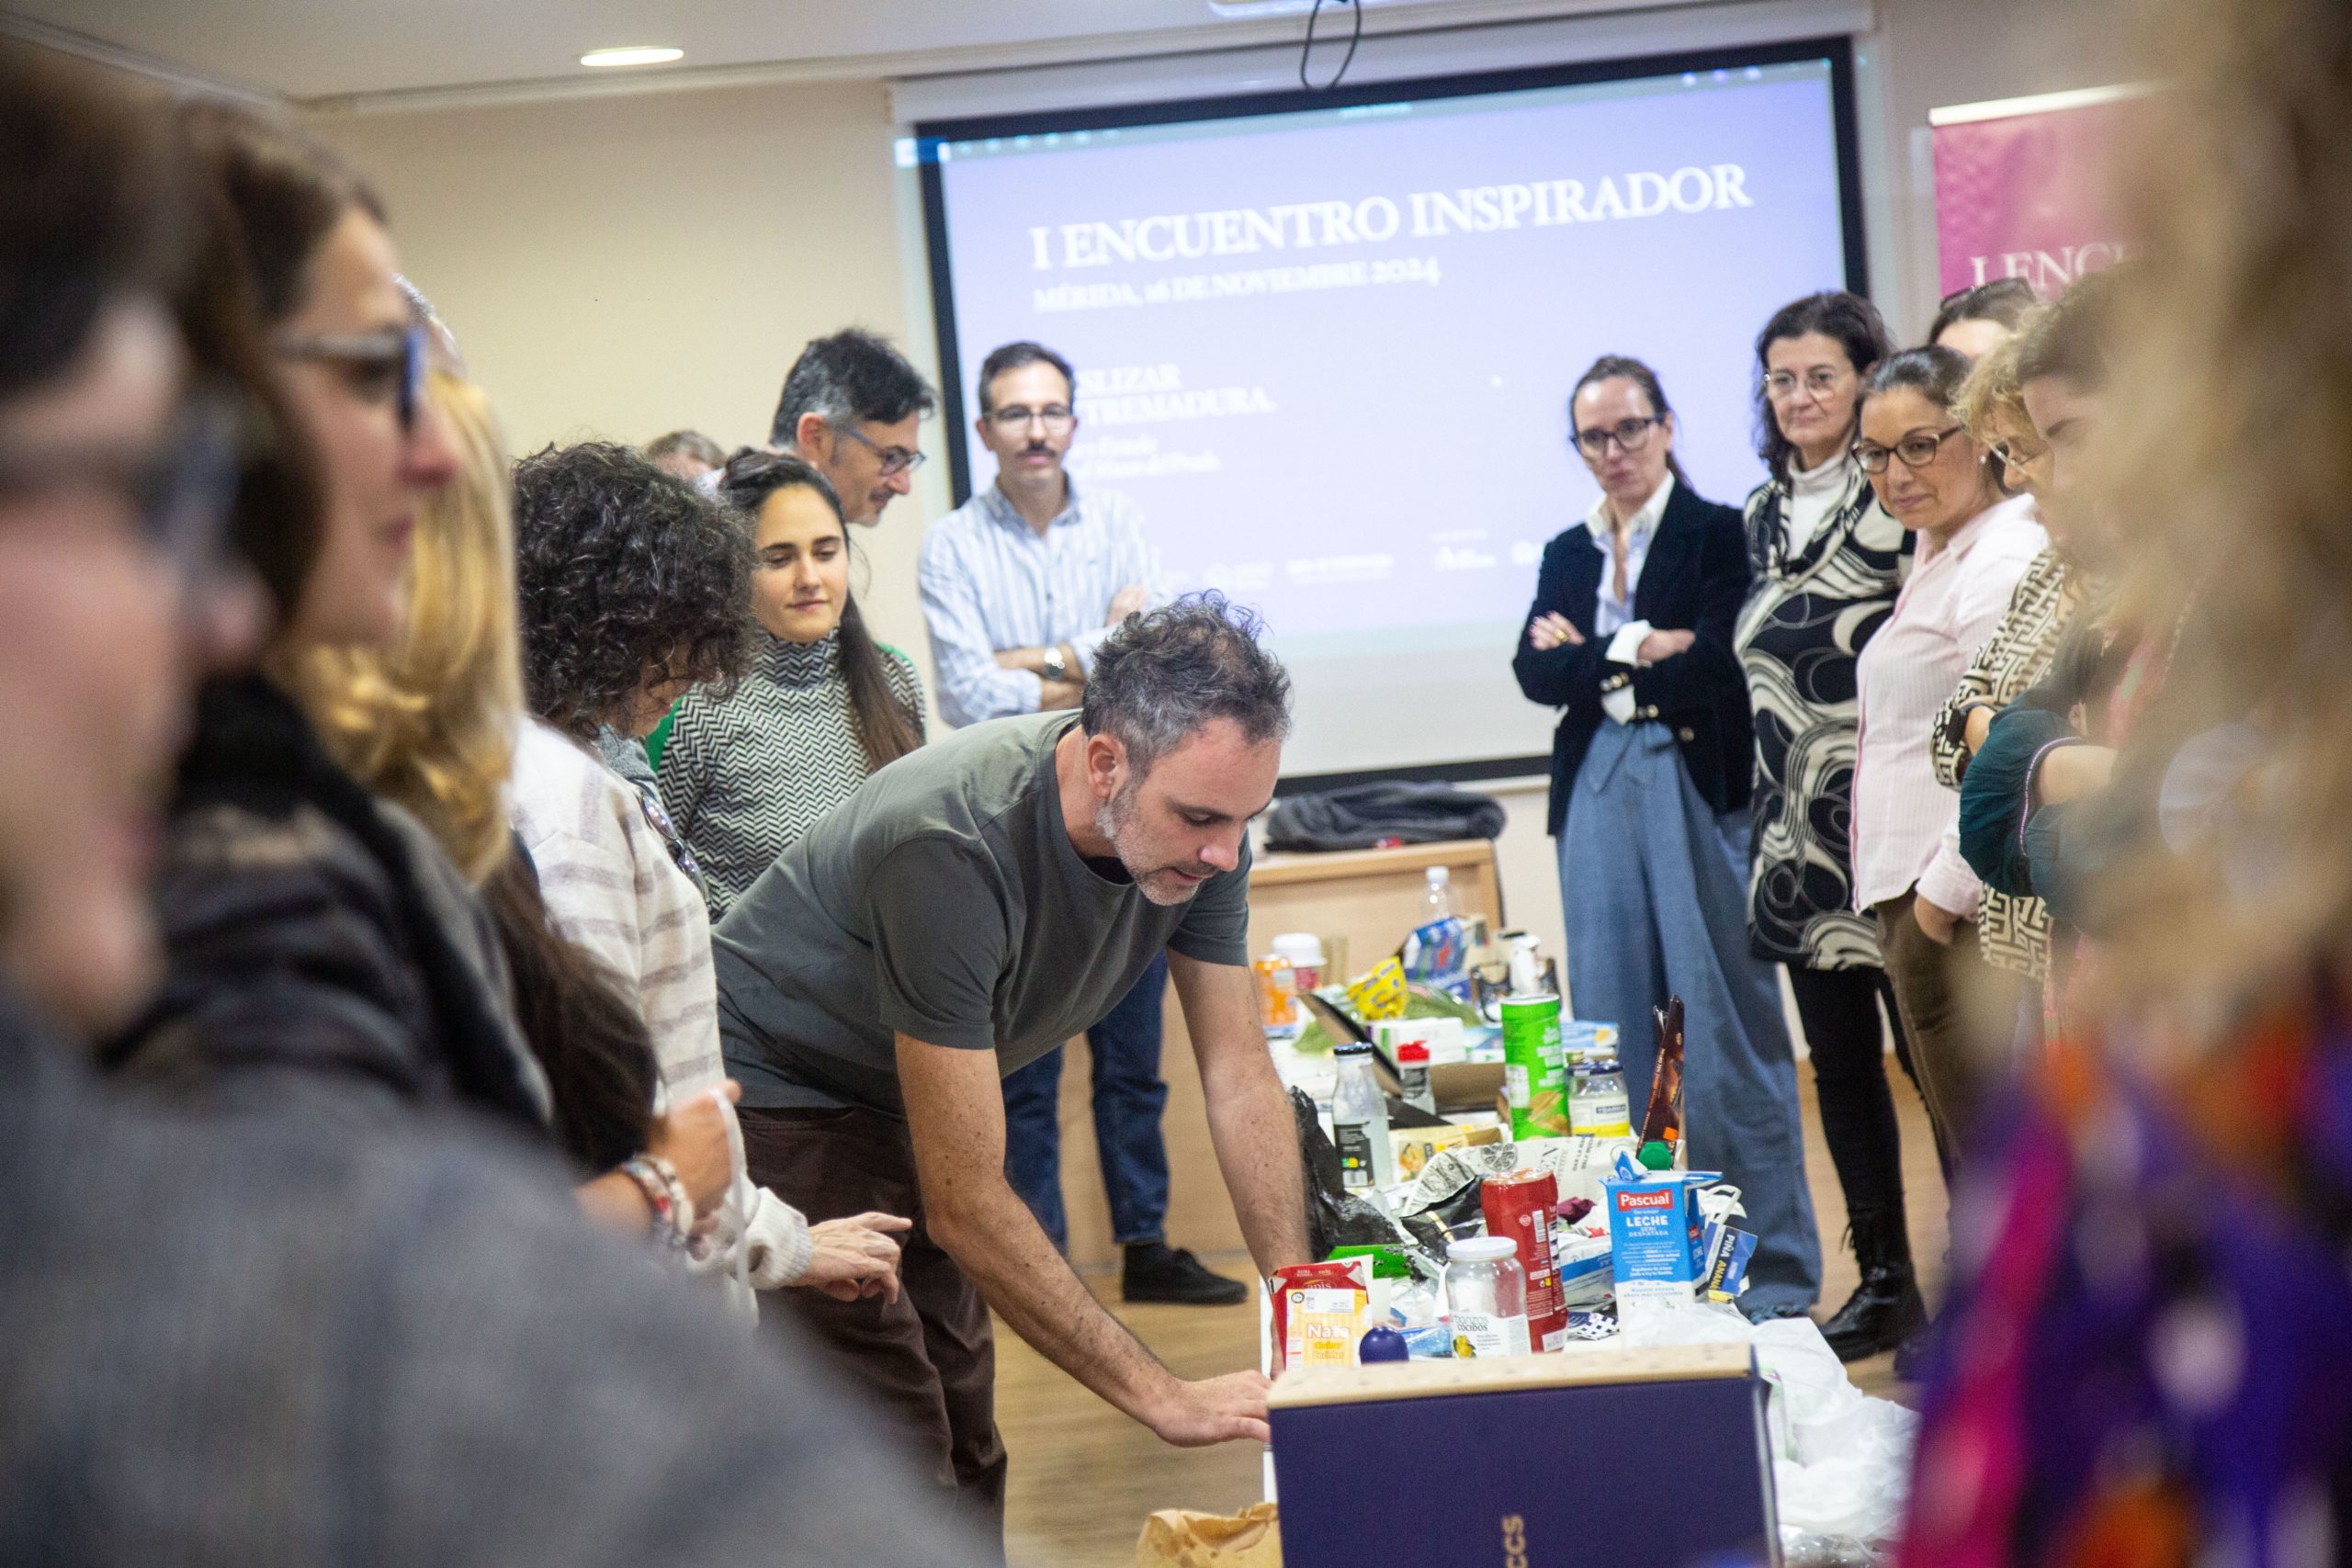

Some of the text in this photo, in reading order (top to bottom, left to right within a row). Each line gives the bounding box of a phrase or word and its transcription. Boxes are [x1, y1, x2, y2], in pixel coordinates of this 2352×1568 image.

[1030, 163, 1755, 272] I ENCUENTRO INSPIRADOR
[1032, 280, 1143, 313] MÉRIDA,
[1171, 274, 1210, 300] DE
[1211, 261, 1368, 296] NOVIEMBRE
[1370, 255, 1442, 285] 2024
[1621, 1193, 1669, 1207] Pascual
[1626, 1215, 1668, 1227] LECHE
[1720, 1234, 1736, 1258] PIÑA
[1307, 1324, 1351, 1338] Nata
